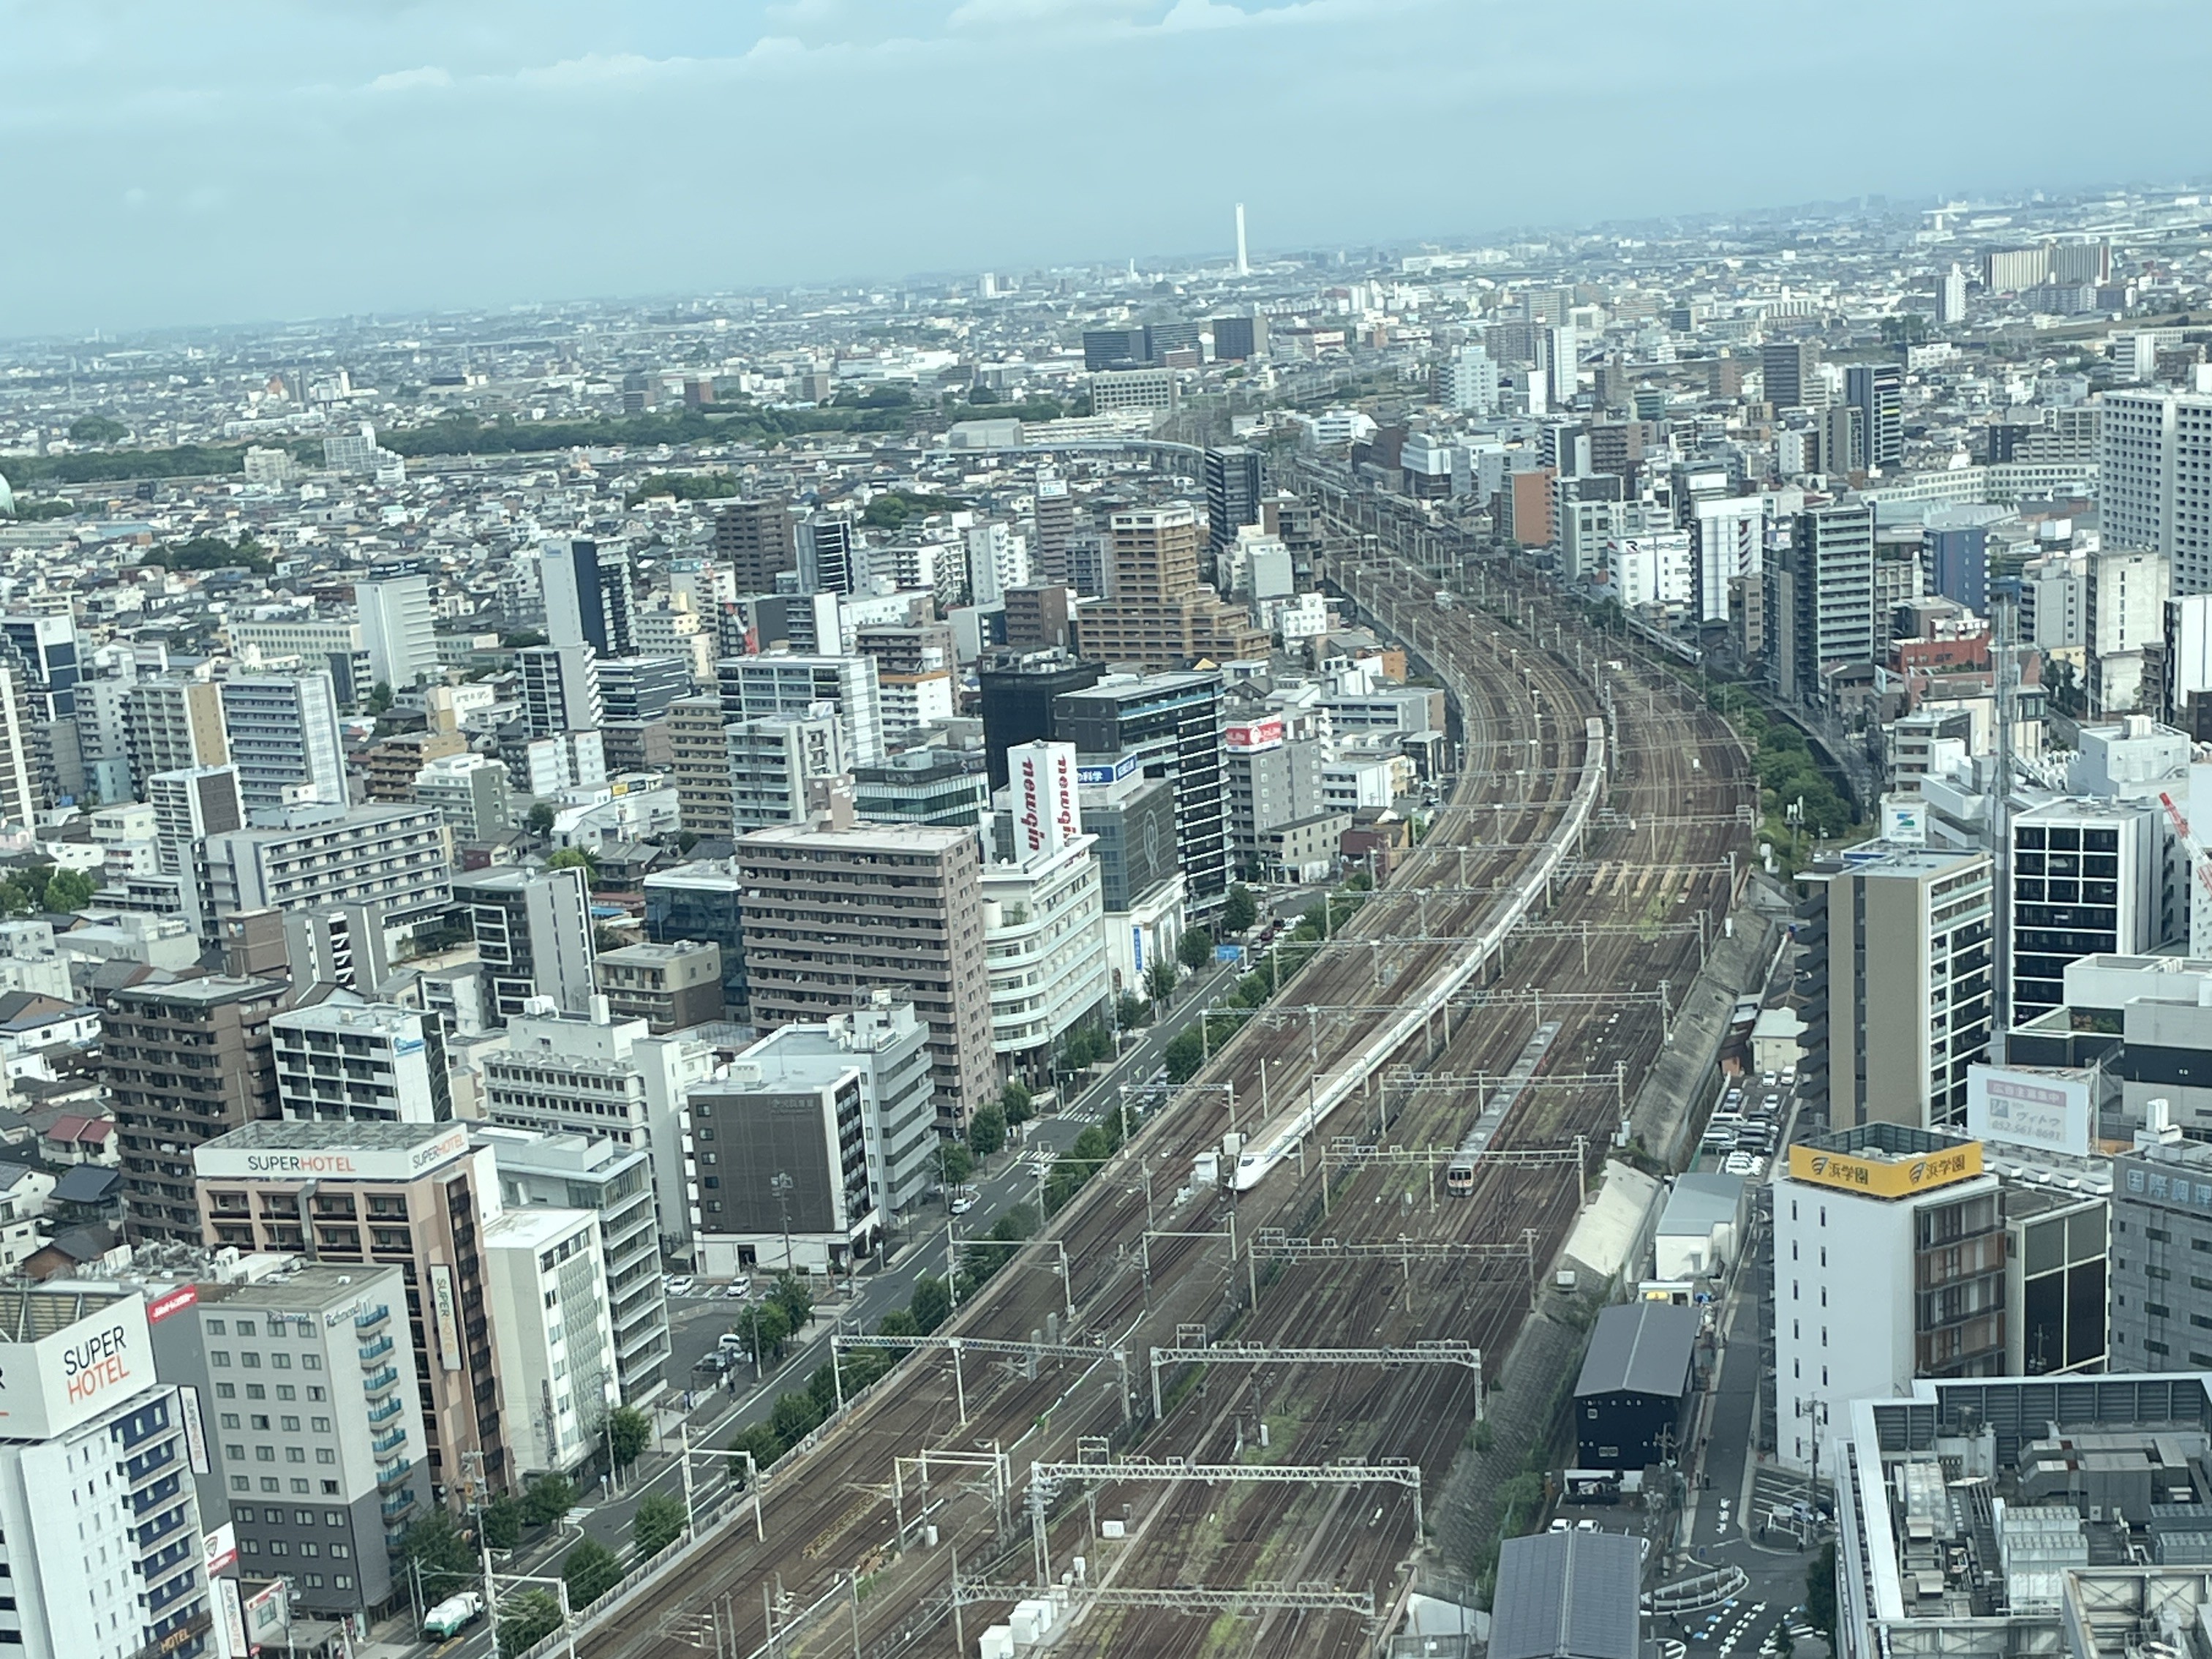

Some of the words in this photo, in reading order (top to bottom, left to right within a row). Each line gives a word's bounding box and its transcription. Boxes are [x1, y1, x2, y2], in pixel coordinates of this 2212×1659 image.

[1829, 1161, 1869, 1185] 浜学園
[1926, 1154, 1965, 1181] 浜学園
[64, 1325, 127, 1376] SUPER
[67, 1355, 130, 1405] HOTEL
[160, 1628, 191, 1654] HOTEL
